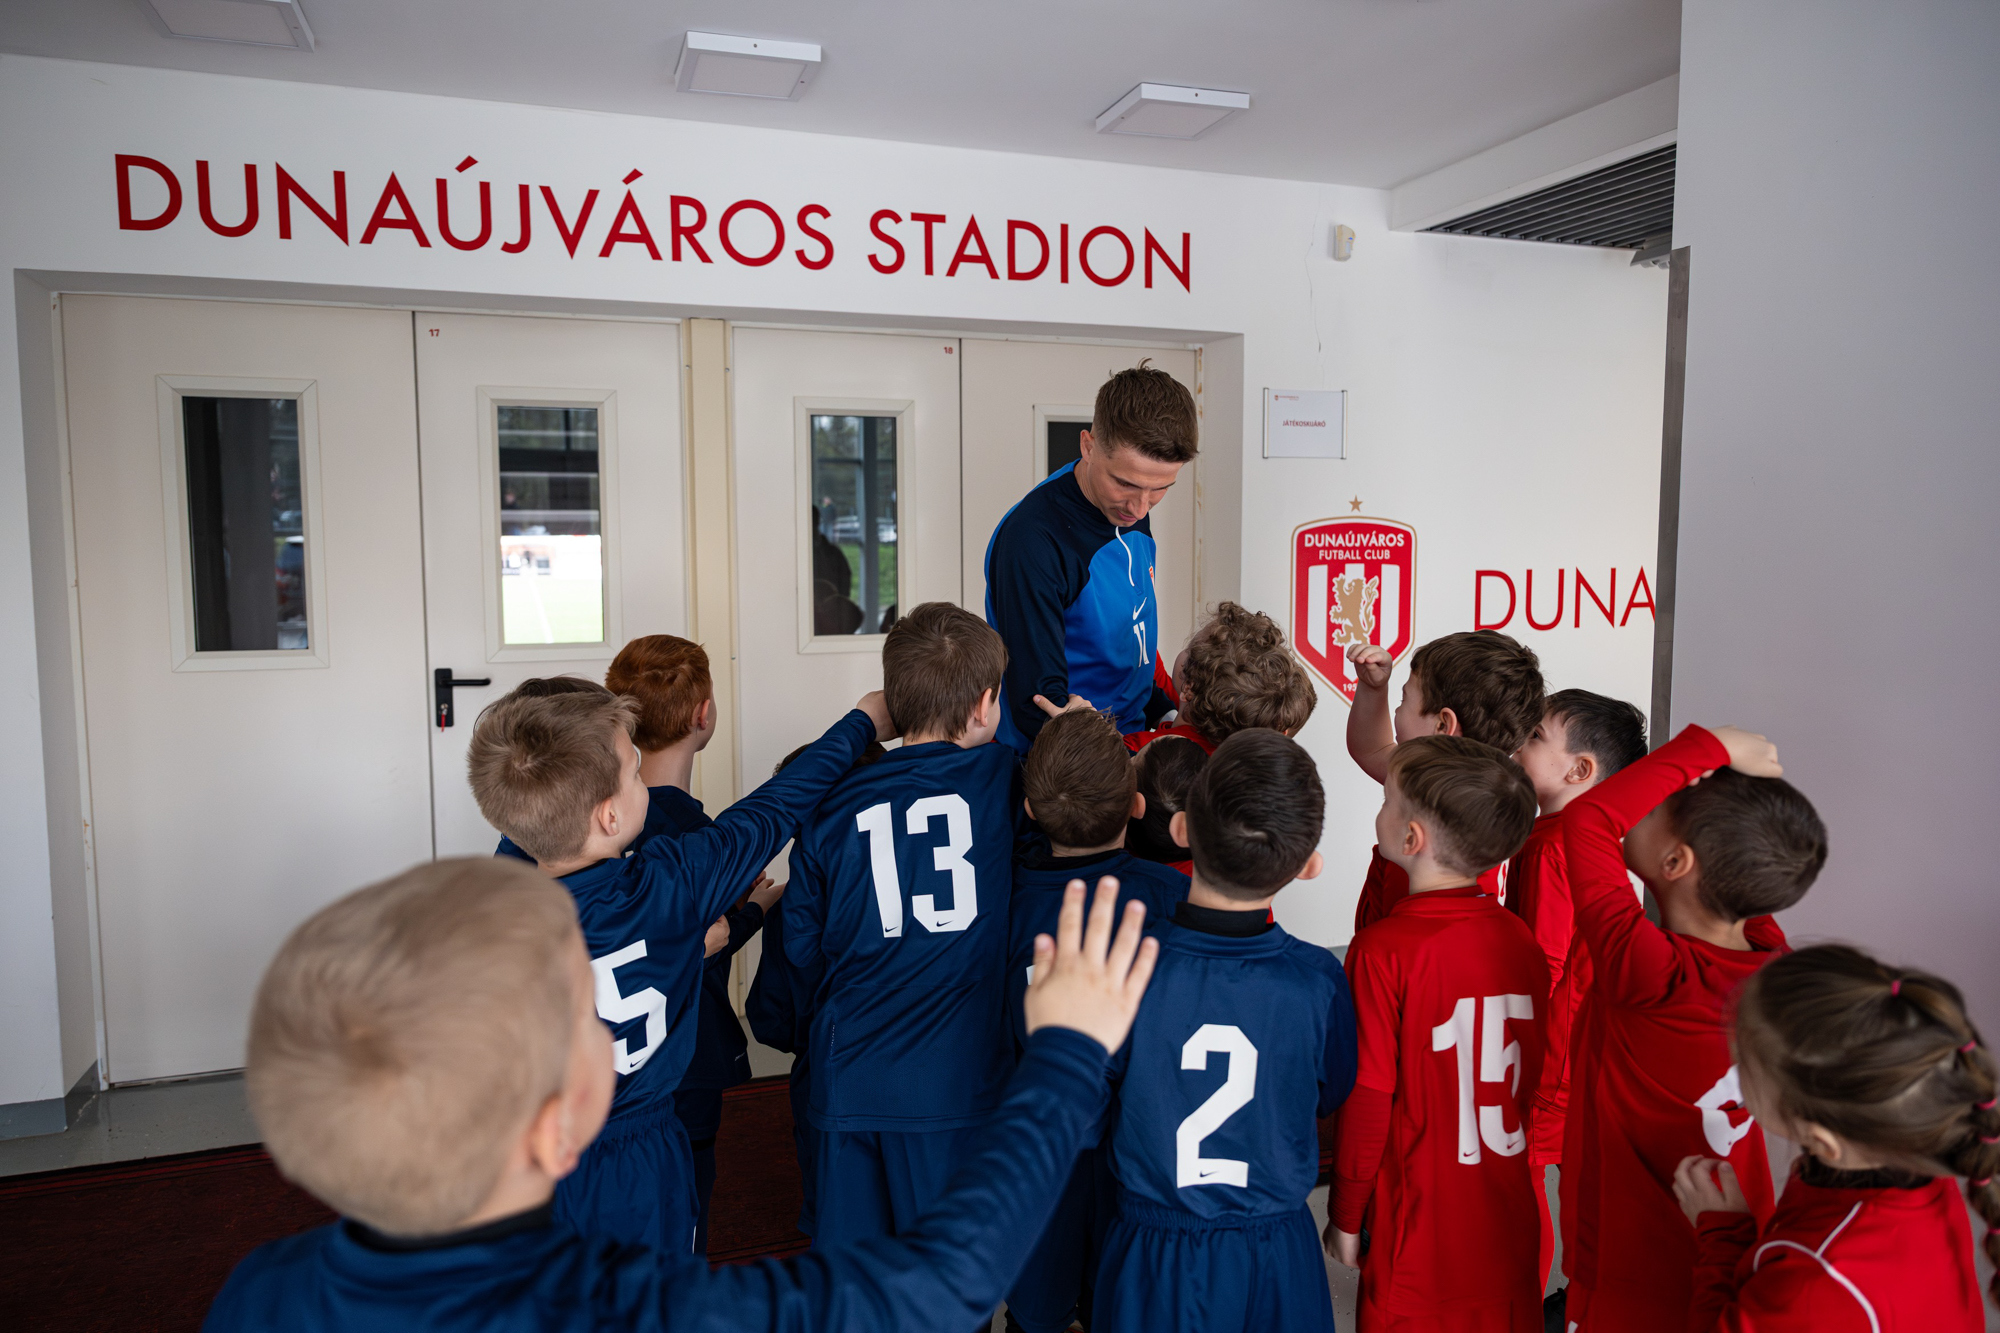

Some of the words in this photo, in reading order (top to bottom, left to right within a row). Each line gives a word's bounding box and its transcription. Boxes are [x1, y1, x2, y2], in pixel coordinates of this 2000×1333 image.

[116, 154, 834, 270] DUNAÚJVÁROS
[868, 208, 1191, 293] STADION
[429, 328, 440, 337] 17
[944, 346, 953, 355] 18
[1304, 530, 1405, 547] DUNAÚJVÁROS
[1319, 549, 1361, 560] FUTBALL
[1364, 549, 1390, 560] CLUB
[1474, 565, 1655, 631] DUNA
[856, 793, 978, 938] 13
[590, 939, 667, 1076] 5
[1176, 1024, 1258, 1188] 2
[1432, 993, 1534, 1165] 15
